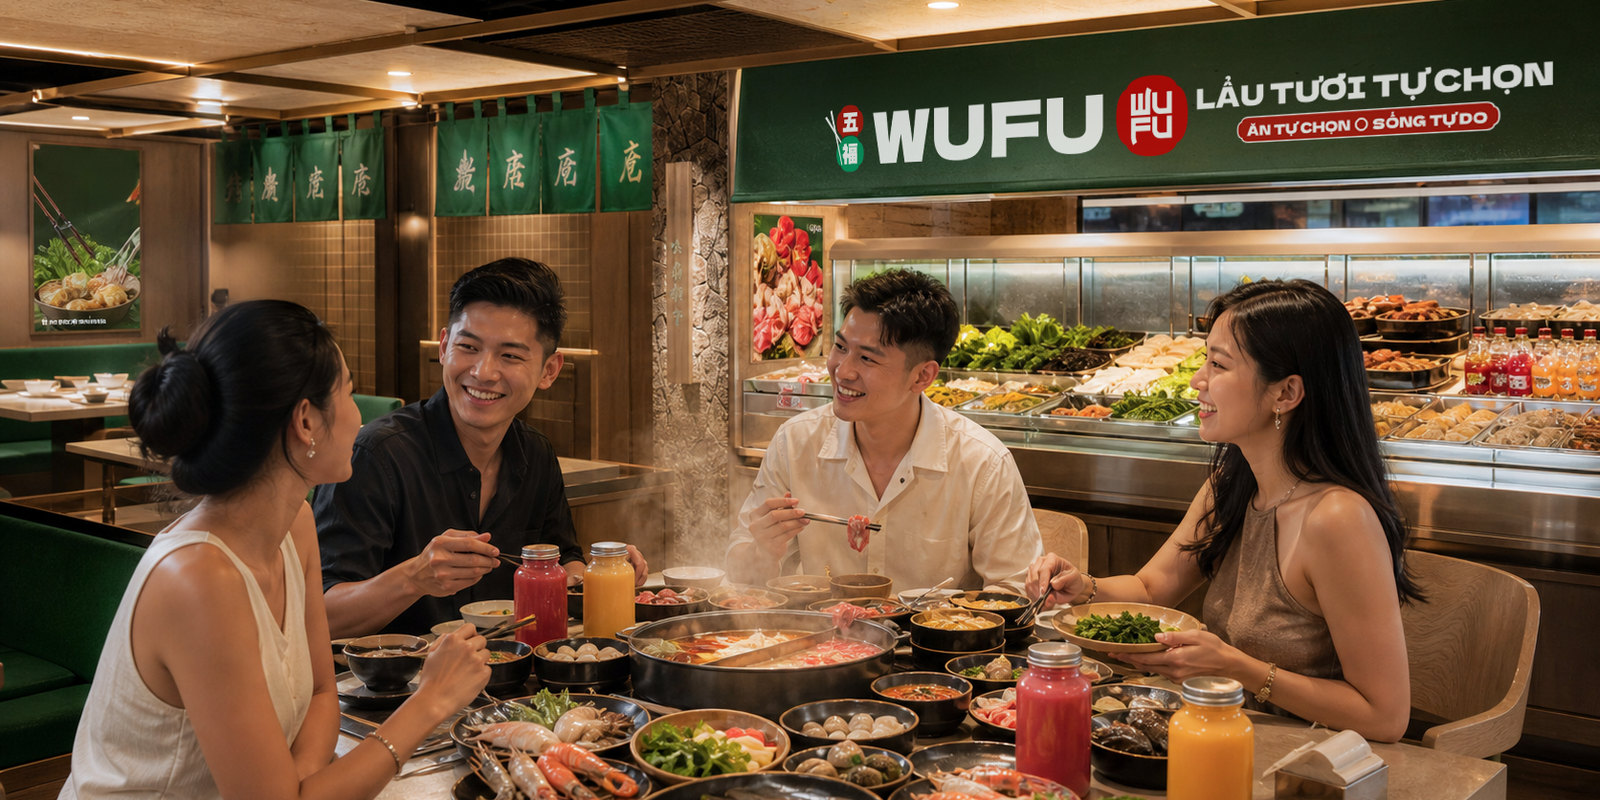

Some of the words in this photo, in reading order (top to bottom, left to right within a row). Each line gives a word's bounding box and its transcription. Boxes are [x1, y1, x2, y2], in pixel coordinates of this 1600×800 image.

[1196, 75, 1264, 110] LẨU
[1270, 73, 1366, 105] TƯƠI
[1372, 67, 1432, 101] TỰ
[1434, 61, 1554, 95] CHỌN
[872, 94, 1104, 165] WUFU
[1247, 122, 1272, 137] ĂN
[1273, 120, 1301, 137] TỰ
[1300, 119, 1351, 135] CHỌN
[1429, 111, 1459, 128] TỰ
[1459, 112, 1488, 125] DO
